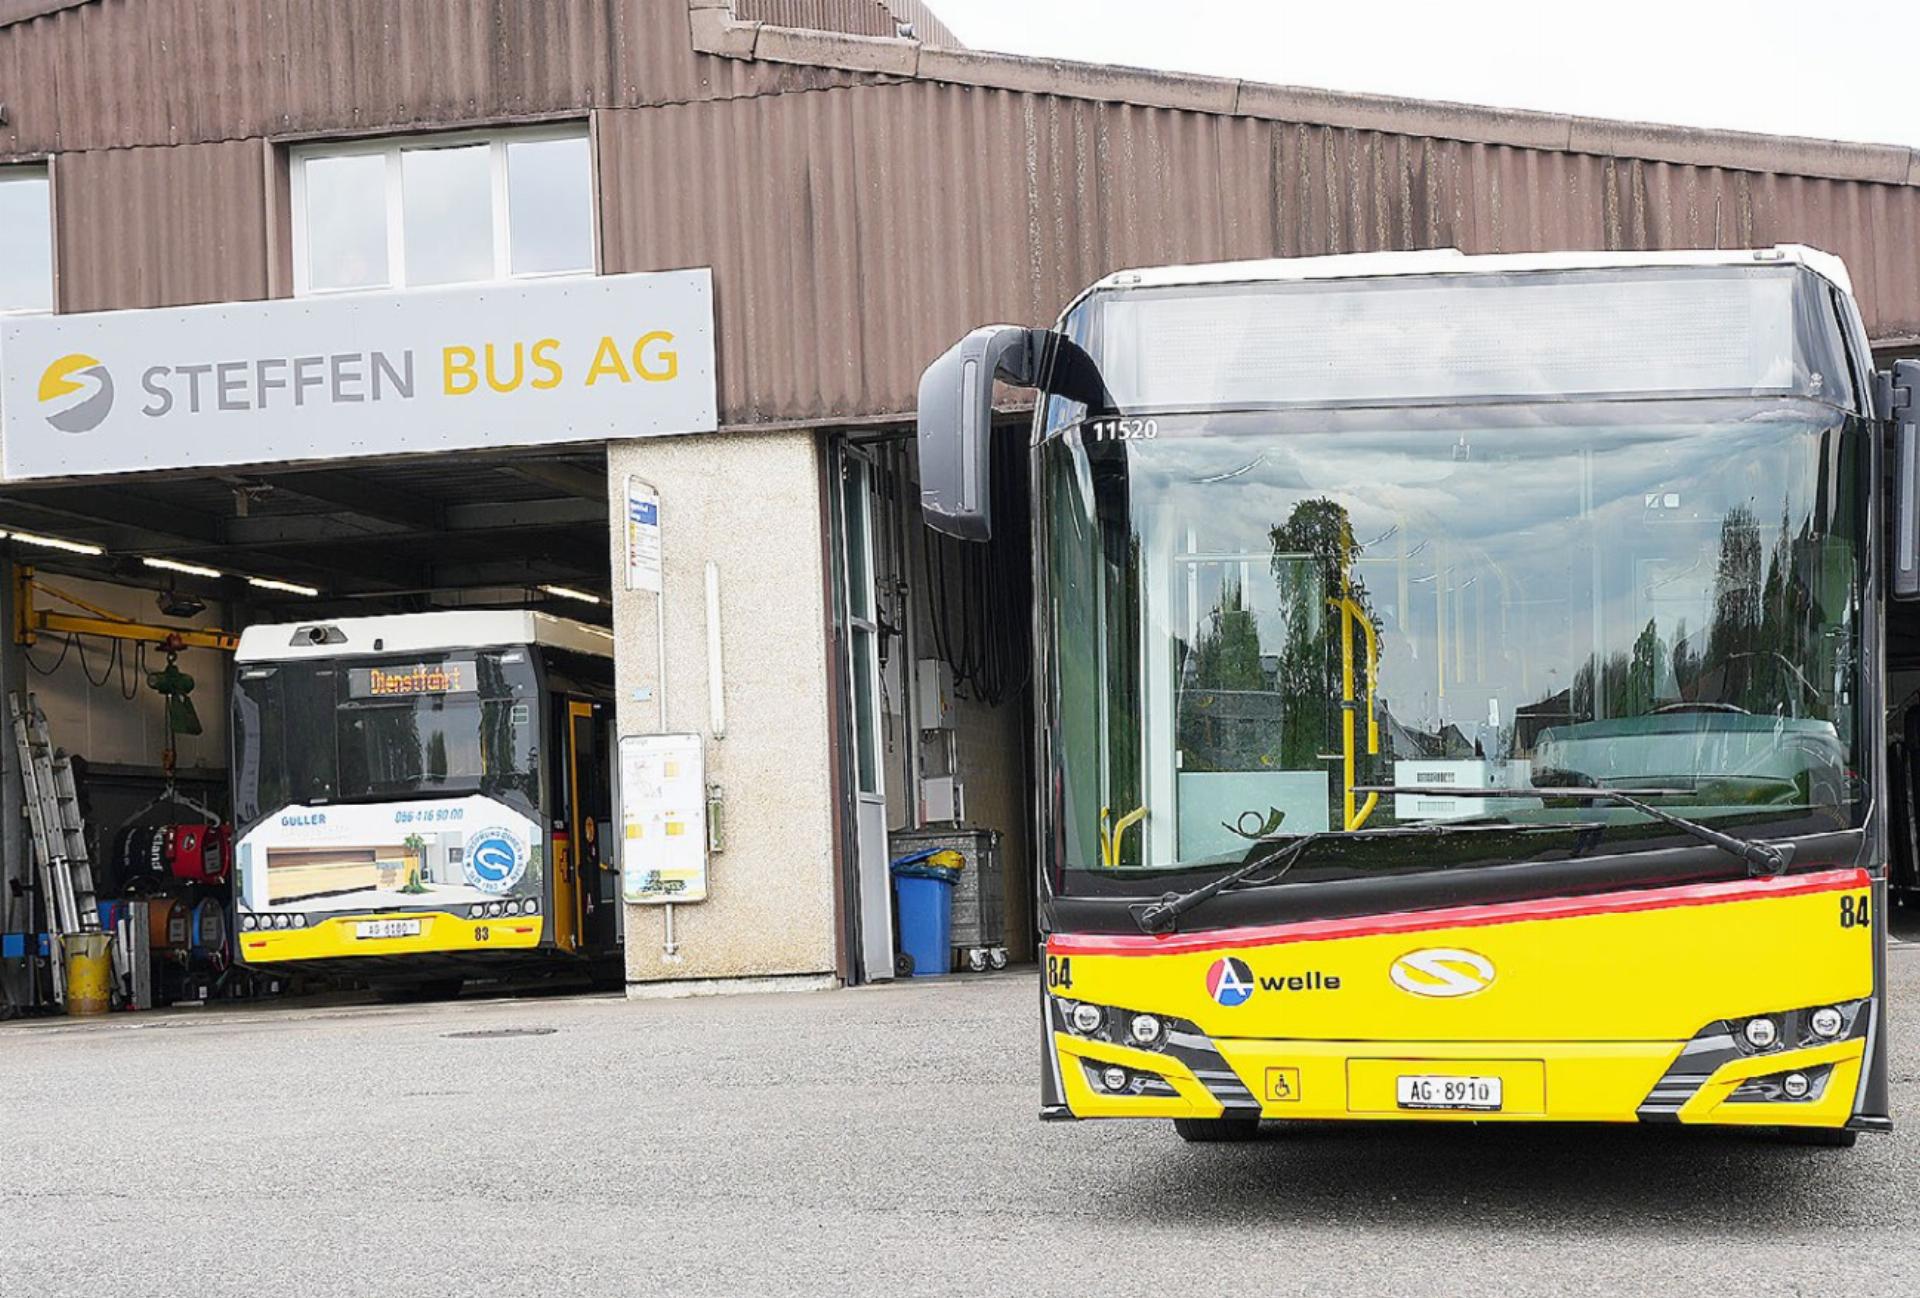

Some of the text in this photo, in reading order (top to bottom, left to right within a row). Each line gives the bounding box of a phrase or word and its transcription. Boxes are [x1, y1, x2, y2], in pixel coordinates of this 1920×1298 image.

[141, 330, 678, 418] STEFFEN BUS AG
[1092, 419, 1158, 442] 11520
[370, 666, 461, 695] Dienstfahrt
[1840, 894, 1870, 928] 84
[474, 926, 489, 942] 83
[1048, 956, 1073, 989] 84
[1259, 970, 1341, 991] welle
[1411, 1080, 1490, 1101] AG 8910
